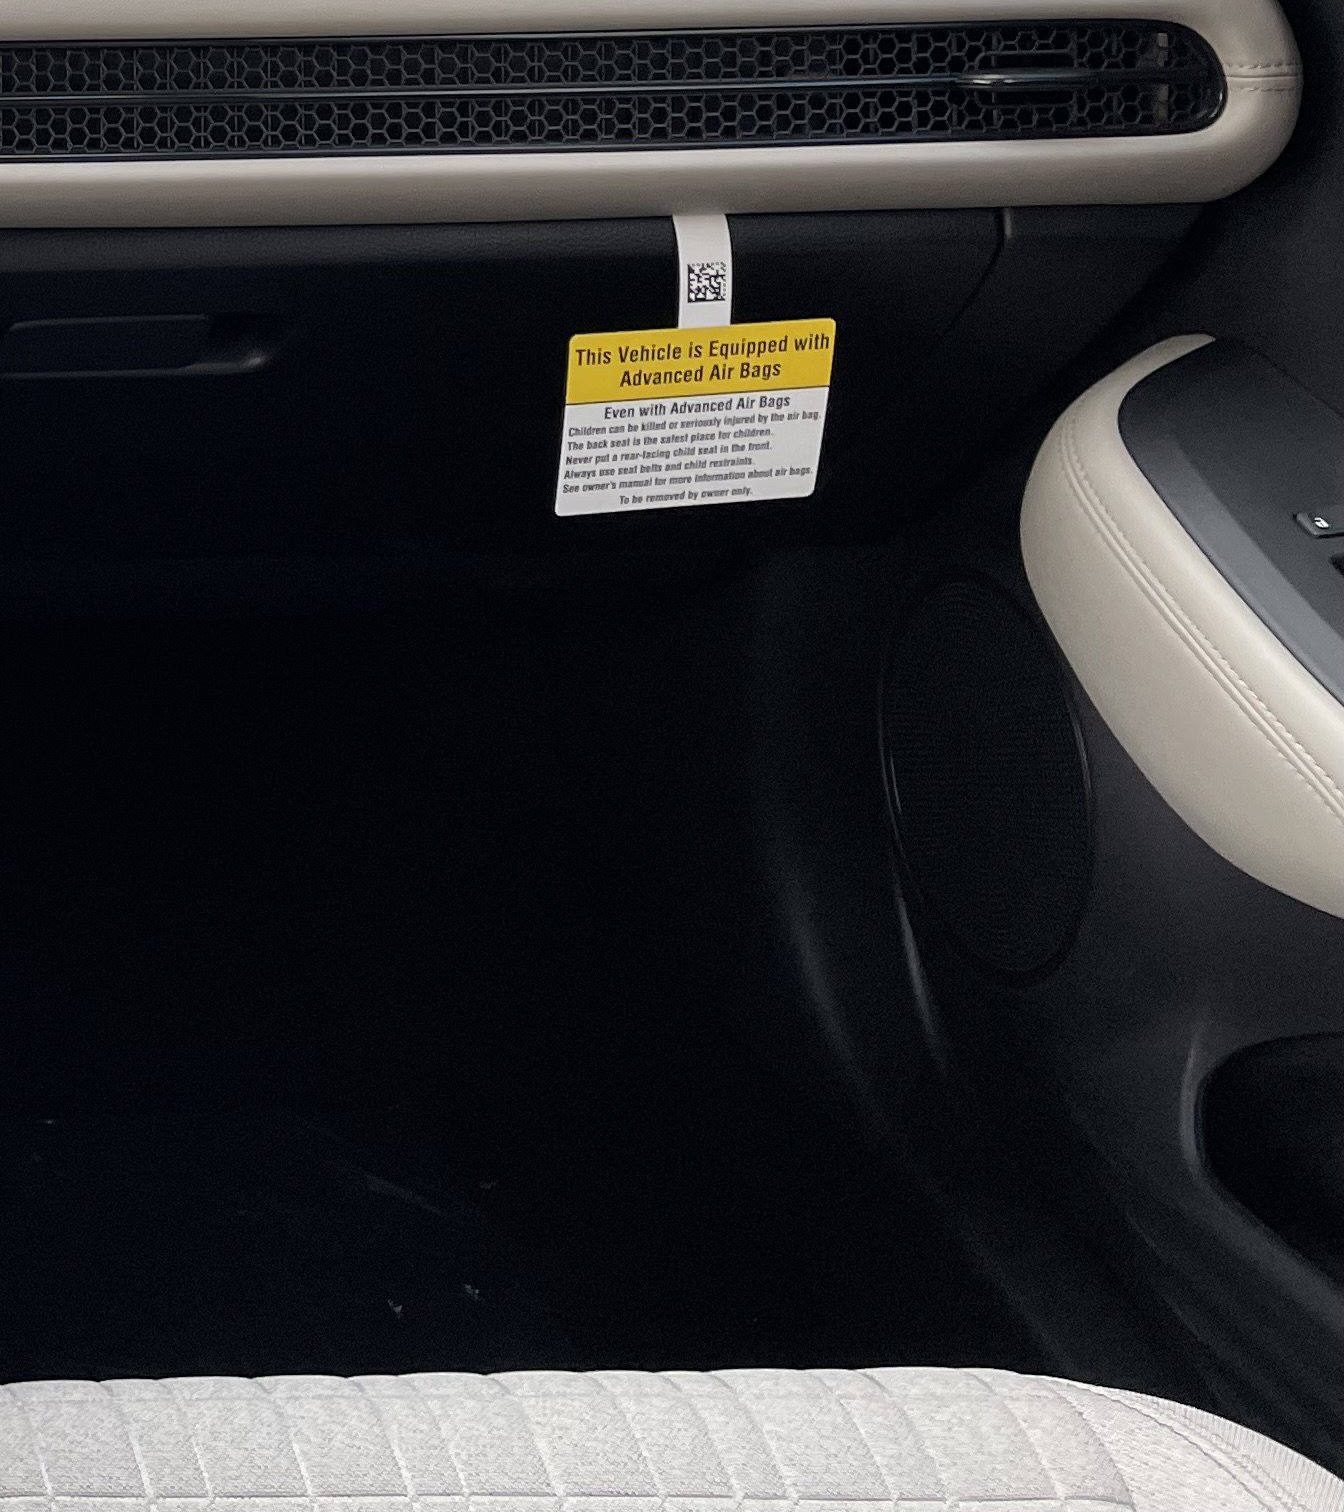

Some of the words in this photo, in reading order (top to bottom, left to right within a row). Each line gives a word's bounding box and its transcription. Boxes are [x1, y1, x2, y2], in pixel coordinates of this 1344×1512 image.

[576, 348, 611, 365] This
[618, 344, 681, 363] Vehicle
[688, 342, 702, 358] is
[709, 335, 787, 361] Equipped
[794, 333, 830, 351] with
[620, 366, 703, 387] Advanced
[709, 364, 733, 380] Air
[740, 362, 781, 380] Bags
[604, 406, 635, 419] Even
[639, 403, 666, 417] with
[670, 398, 732, 415] Advanced
[736, 398, 756, 410] Air
[760, 395, 790, 410] Bags
[569, 425, 606, 437] Children
[609, 425, 625, 434] can
[627, 422, 638, 433] be
[641, 420, 666, 431] killed
[669, 421, 678, 429] or
[680, 416, 721, 429] seriously
[723, 413, 755, 426] injured
[758, 413, 768, 424] by
[771, 412, 785, 422] the
[787, 411, 800, 421] air
[802, 410, 821, 422] bag.
[568, 441, 584, 451] The
[587, 439, 607, 450] back
[610, 438, 630, 448] seat
[633, 437, 641, 446] is
[643, 435, 657, 445] the
[660, 433, 688, 444] safest
[691, 431, 715, 443] place
[718, 430, 731, 440] for
[733, 428, 773, 439] children.
[566, 455, 592, 465] Never
[595, 454, 610, 465] put
[620, 449, 670, 462] rear-facing
[673, 447, 695, 458] child
[698, 446, 717, 456] seat
[720, 445, 729, 454] in
[731, 443, 745, 453] the
[563, 483, 579, 493] See
[582, 480, 616, 492] owner's
[619, 478, 652, 489] manual
[655, 476, 667, 486] for
[669, 475, 692, 485] more
[694, 471, 746, 483] information
[748, 468, 773, 479] about
[775, 467, 787, 476] air
[564, 469, 596, 480] Always
[599, 467, 615, 476] use
[618, 464, 637, 475] seat
[640, 463, 662, 474] belts
[665, 461, 682, 472] and
[684, 459, 707, 470] child
[709, 456, 755, 468] restraints.
[619, 495, 629, 505] To
[632, 493, 643, 503] be
[645, 490, 685, 502] removed
[687, 489, 698, 501] by
[701, 488, 729, 498] owner
